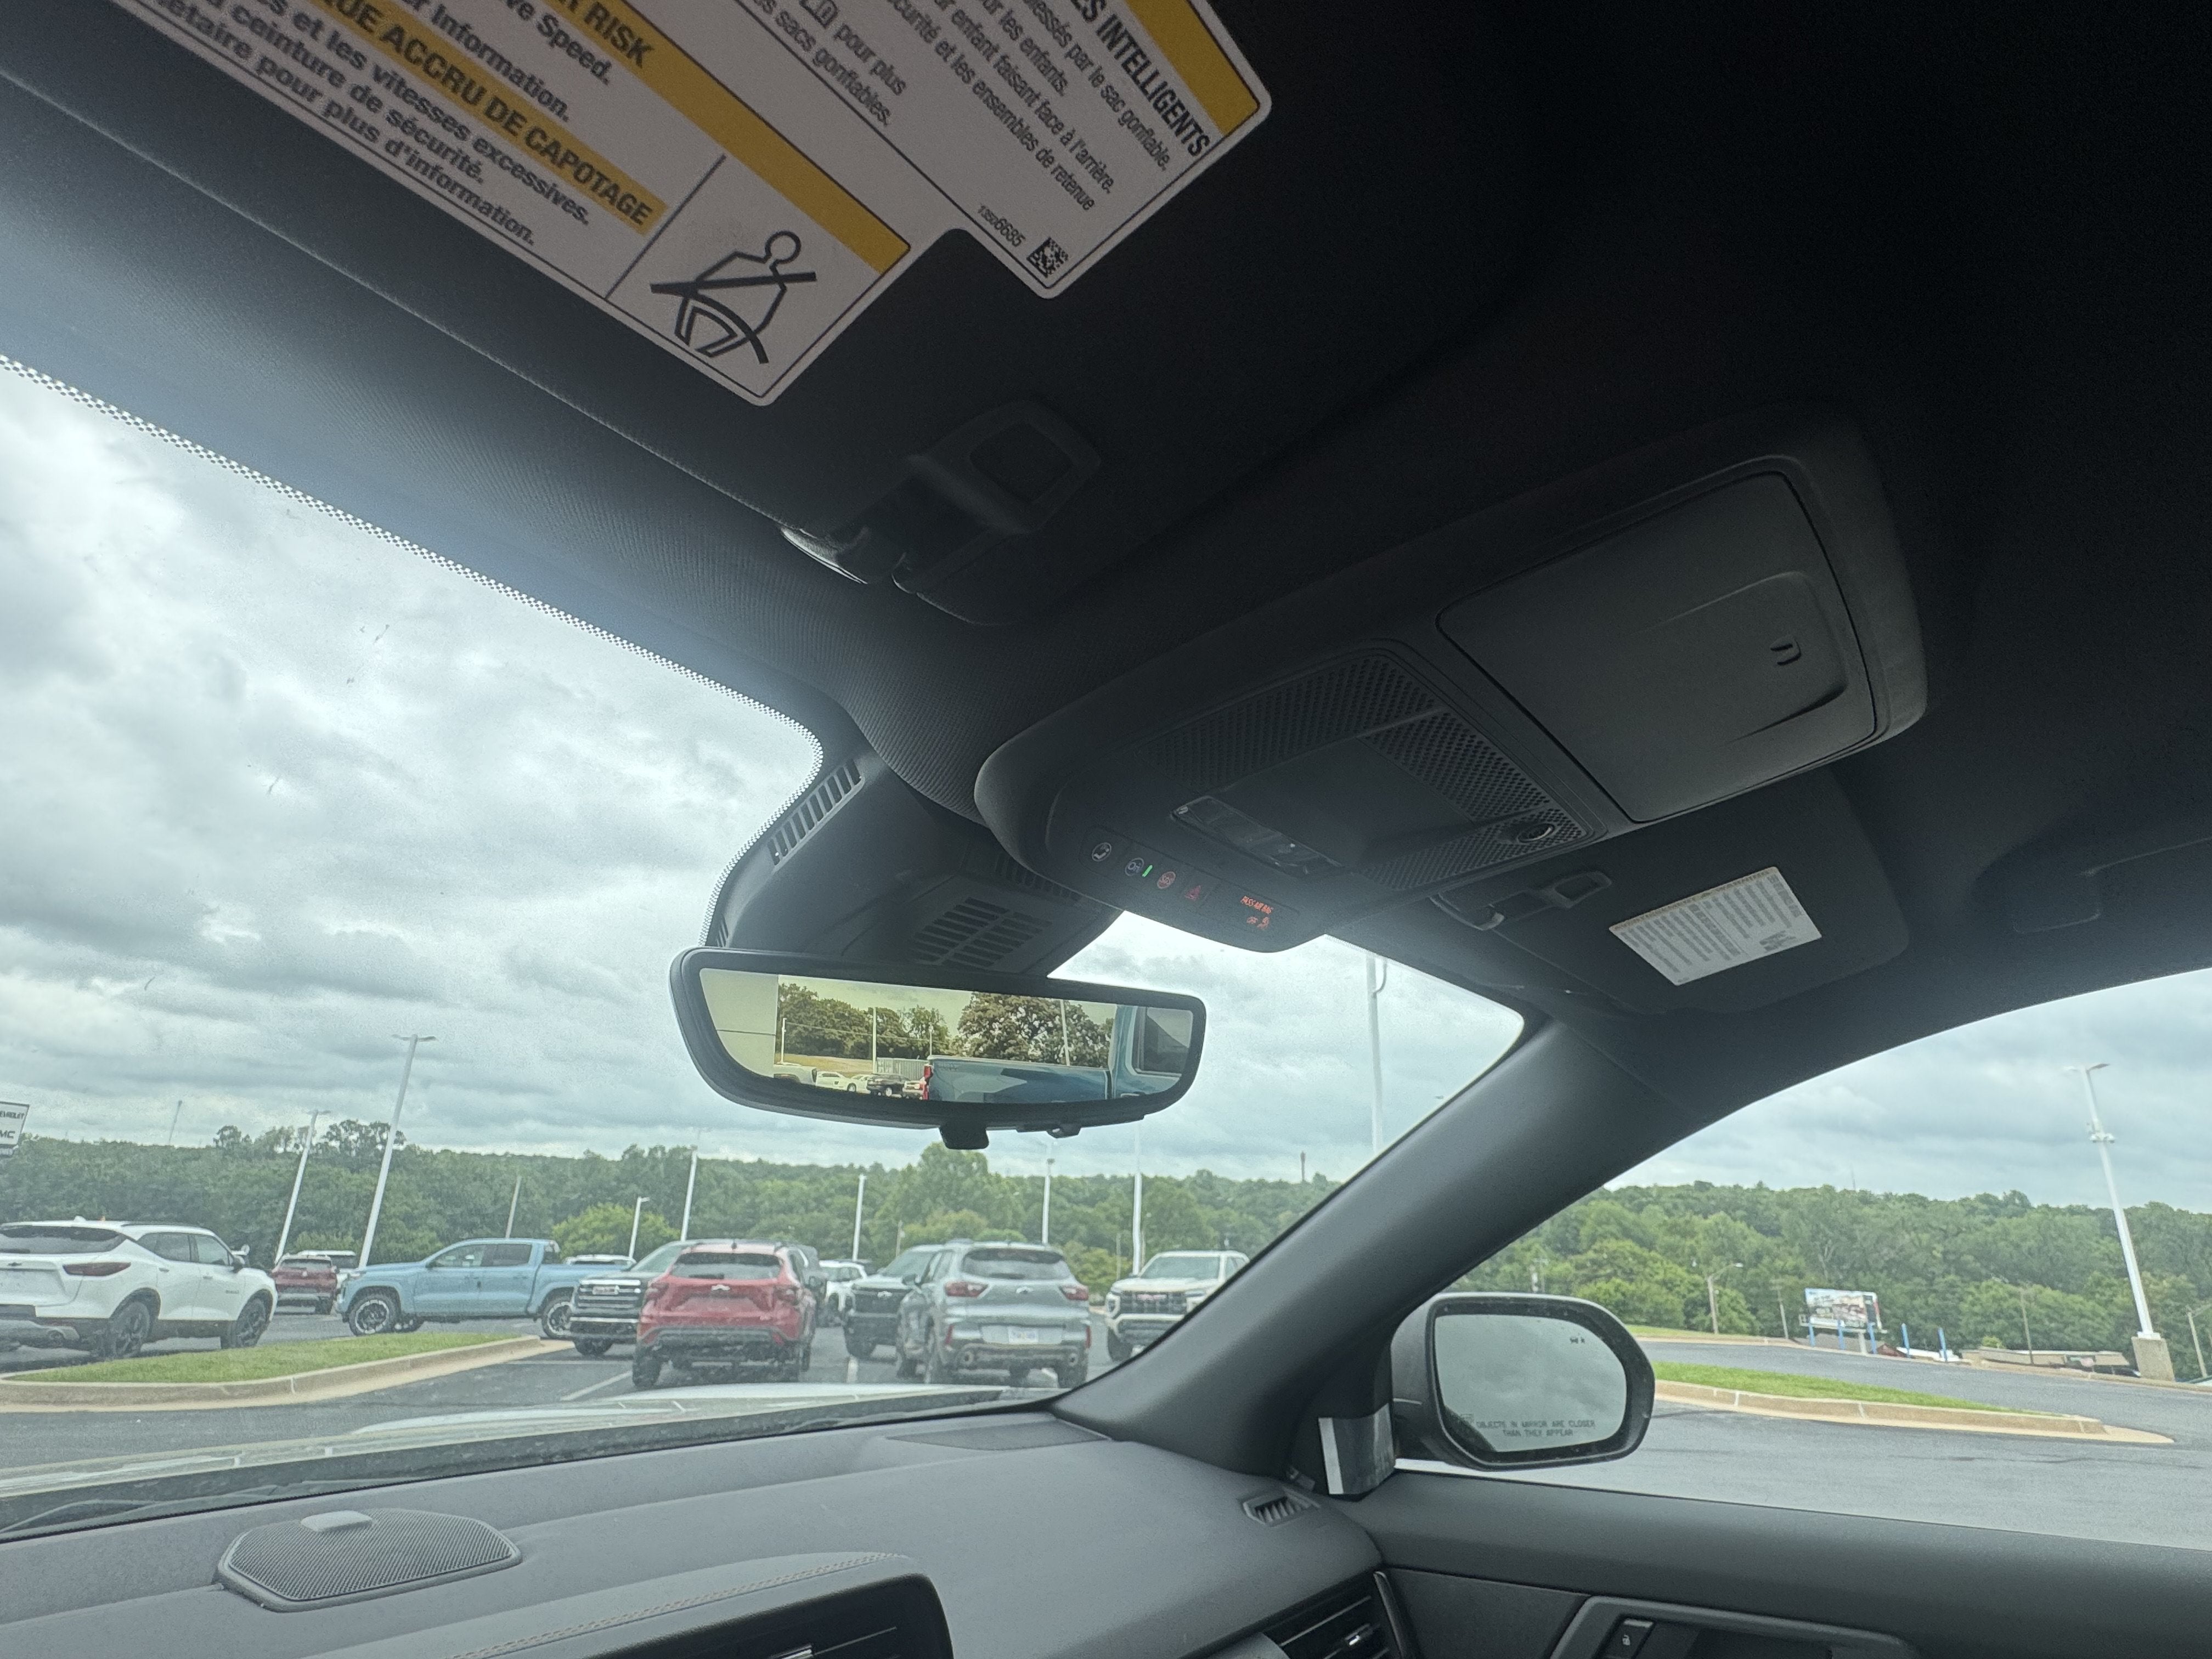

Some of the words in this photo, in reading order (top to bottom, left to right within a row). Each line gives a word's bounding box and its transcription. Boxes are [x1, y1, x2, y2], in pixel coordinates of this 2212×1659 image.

[230, 5, 347, 89] ceinture
[350, 83, 383, 114] de
[386, 109, 484, 184] sécurité.
[431, 4, 569, 122] Information.
[536, 12, 611, 86] Speed.
[583, 2, 654, 69] RISK
[775, 10, 816, 53] sacs
[833, 23, 876, 64] pour
[868, 59, 906, 97] plus
[998, 8, 1024, 41] les
[1019, 37, 1069, 97] enfants.
[1064, 43, 1094, 72] par
[1088, 65, 1105, 88] le
[1100, 83, 1126, 113] sac
[1096, 13, 1210, 156] INTELLIGENTS
[256, 55, 323, 103] pour
[323, 99, 380, 143] plus
[385, 137, 534, 246] d'information.
[294, 12, 324, 41] et
[326, 30, 368, 70] les
[373, 64, 471, 142] vitesses
[472, 137, 590, 225] excessives.
[379, 24, 487, 106] ACCRU
[484, 97, 528, 137] DE
[524, 126, 654, 225] CAPOTAGE
[934, 40, 957, 63] et
[950, 54, 976, 84] les
[972, 80, 1039, 151] ensembles
[1035, 148, 1054, 169] de
[1050, 163, 1095, 211] retenue
[951, 9, 1000, 62] enfant
[992, 54, 1041, 108] faisant
[1034, 99, 1064, 136] face
[1059, 127, 1076, 146] à
[1068, 137, 1114, 194] l'arrière.
